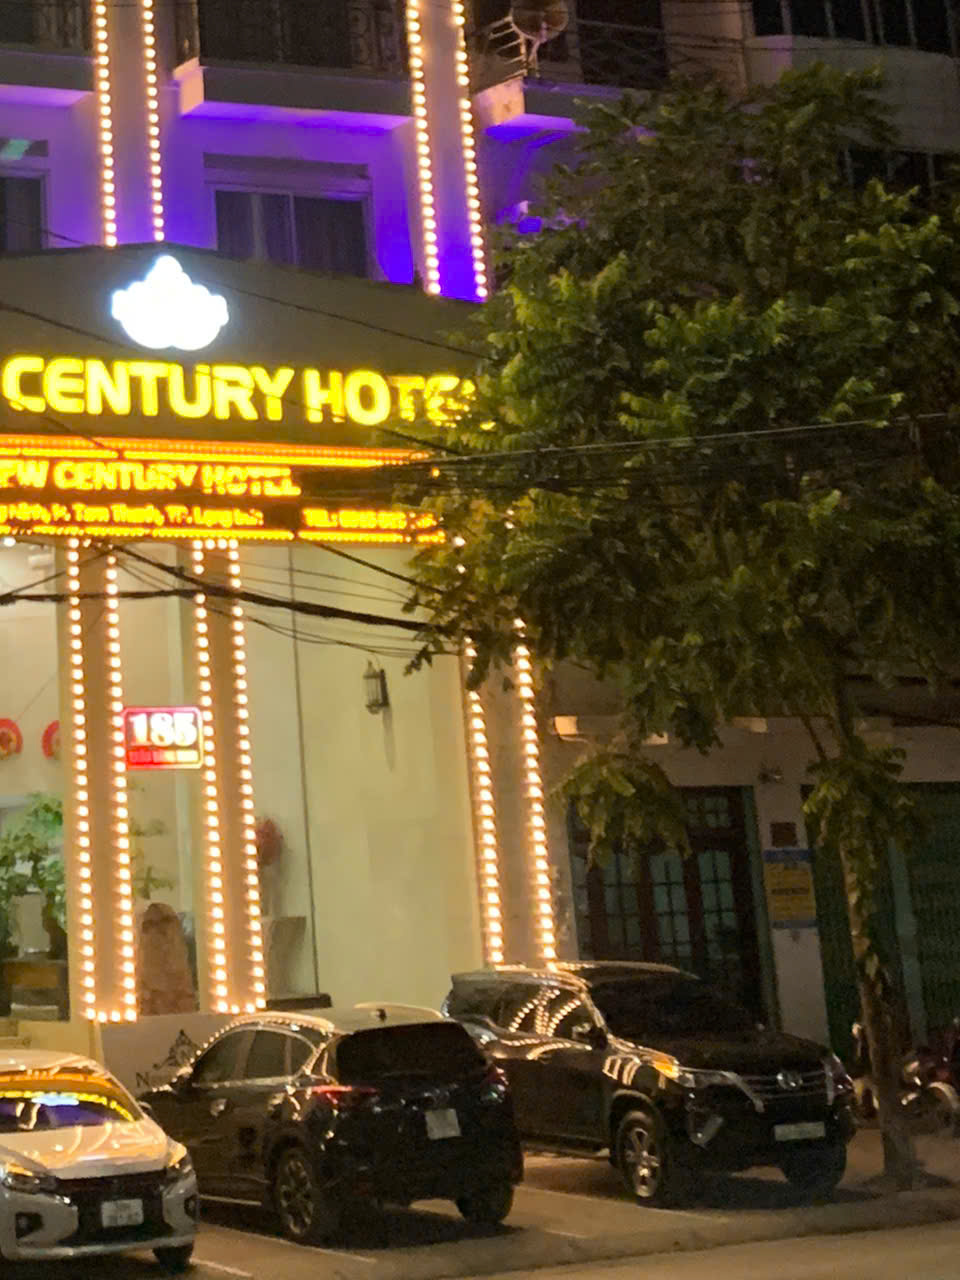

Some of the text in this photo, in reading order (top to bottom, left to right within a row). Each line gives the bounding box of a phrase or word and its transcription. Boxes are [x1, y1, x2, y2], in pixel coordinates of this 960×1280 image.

[2, 356, 295, 419] CENTURY
[53, 460, 199, 491] CENTURY
[201, 464, 302, 497] HOTEL
[129, 712, 198, 747] 185
